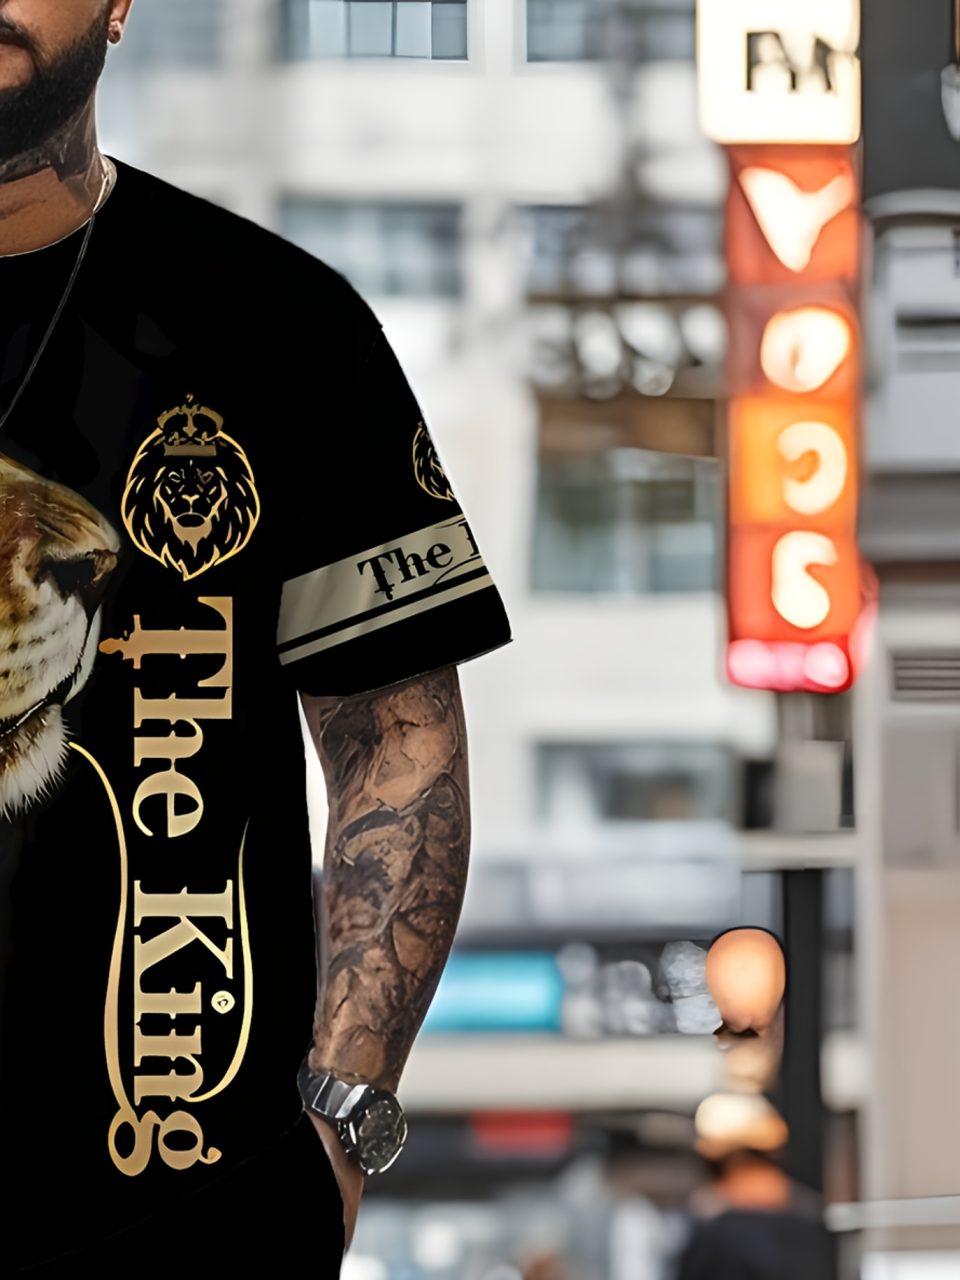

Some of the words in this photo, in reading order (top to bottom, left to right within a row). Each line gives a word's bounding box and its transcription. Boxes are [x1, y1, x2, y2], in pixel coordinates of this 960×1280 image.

[356, 542, 454, 601] The
[98, 596, 235, 839] The
[107, 878, 238, 1178] King
